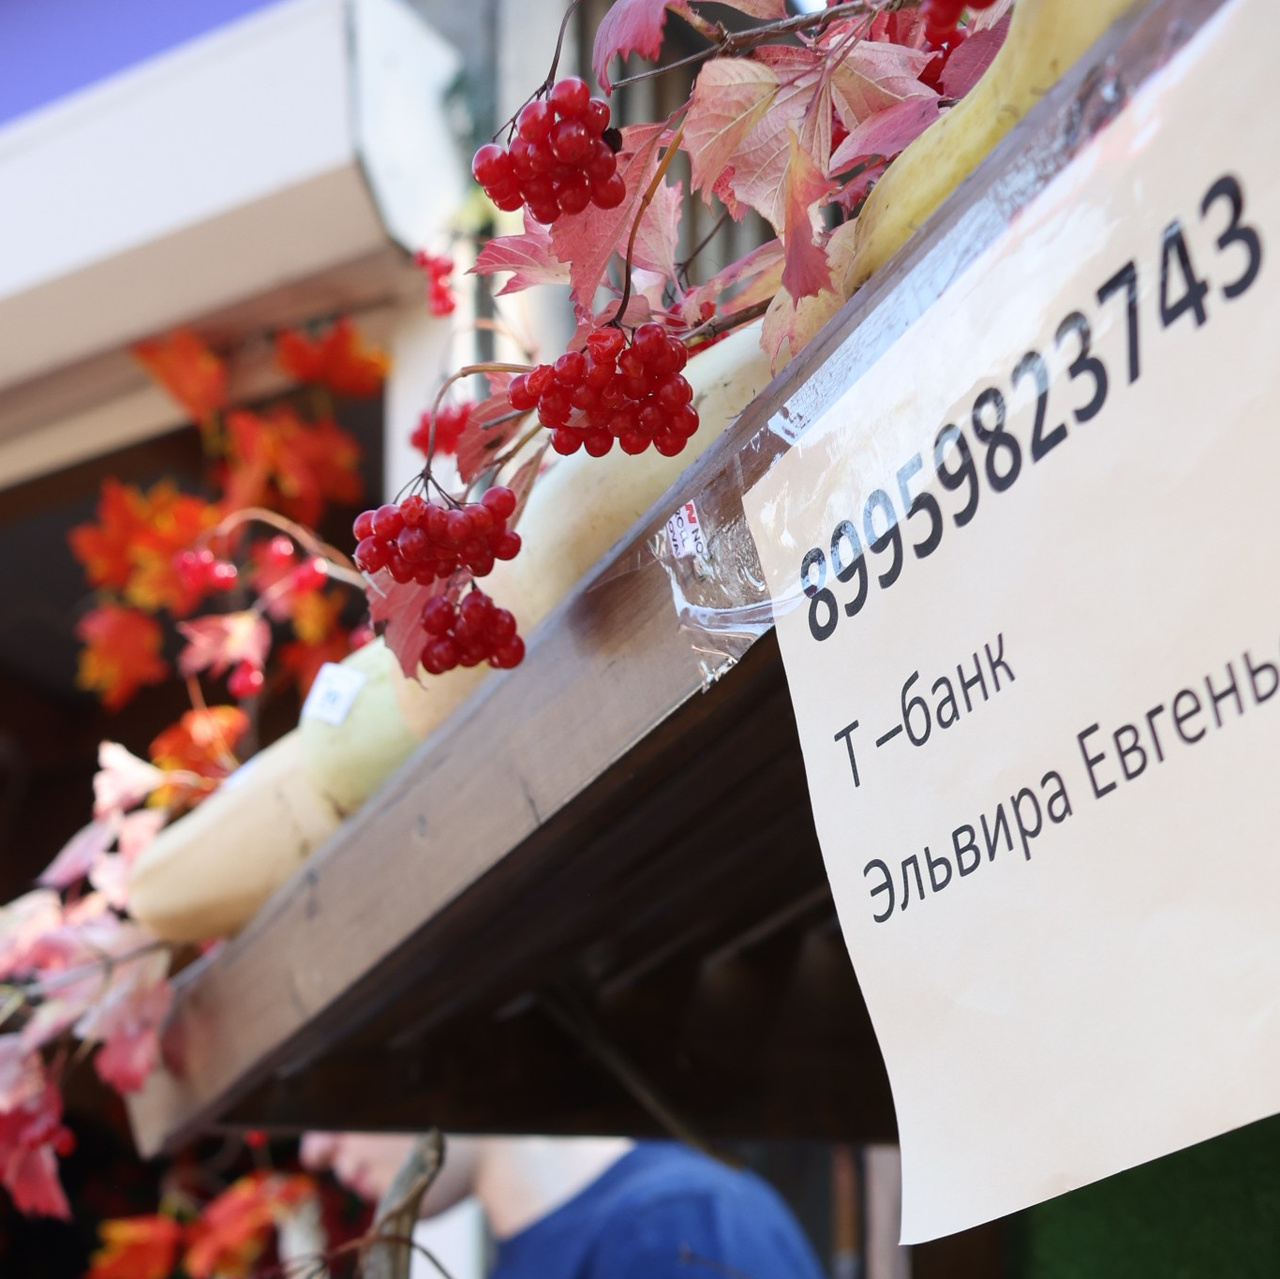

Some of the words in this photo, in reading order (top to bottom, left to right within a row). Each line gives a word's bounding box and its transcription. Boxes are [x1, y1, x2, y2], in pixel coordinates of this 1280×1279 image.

[800, 173, 1264, 642] 89959823743
[863, 770, 1073, 923] Эльвира
[1076, 648, 1280, 800] Евгень
